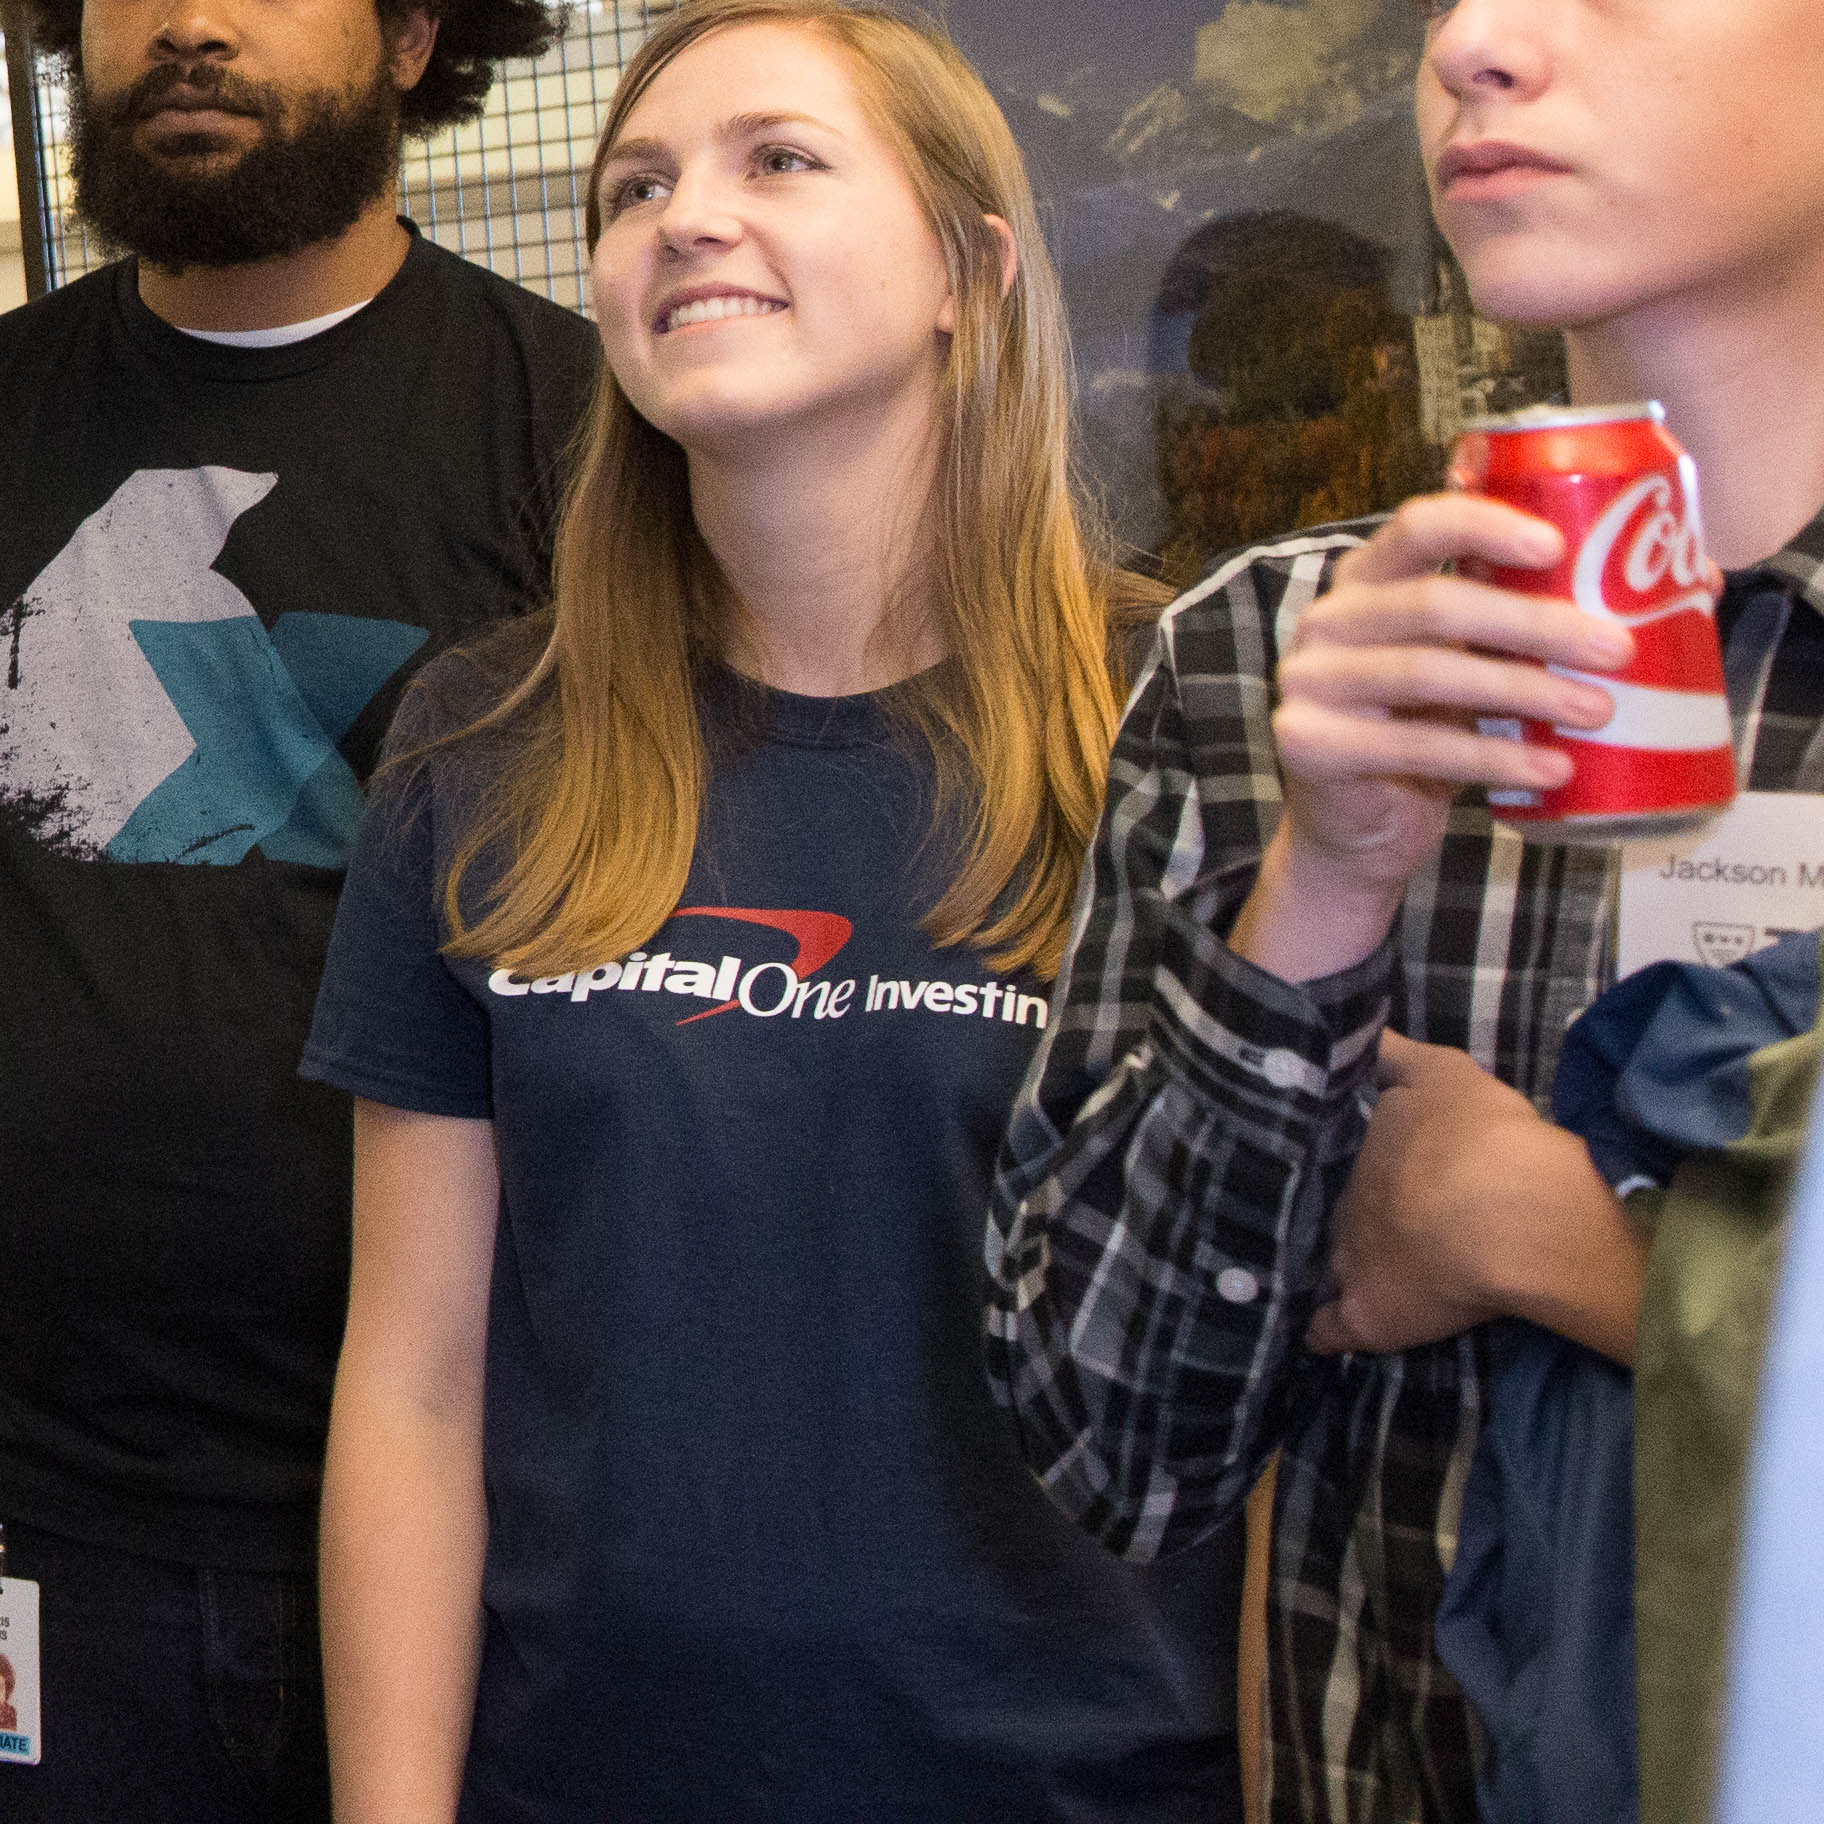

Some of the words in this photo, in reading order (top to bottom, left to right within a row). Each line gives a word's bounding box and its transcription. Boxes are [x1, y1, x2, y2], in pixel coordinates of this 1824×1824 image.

[1659, 853, 1786, 886] Jackson
[738, 962, 856, 1020] One
[865, 974, 1050, 1030] Investin
